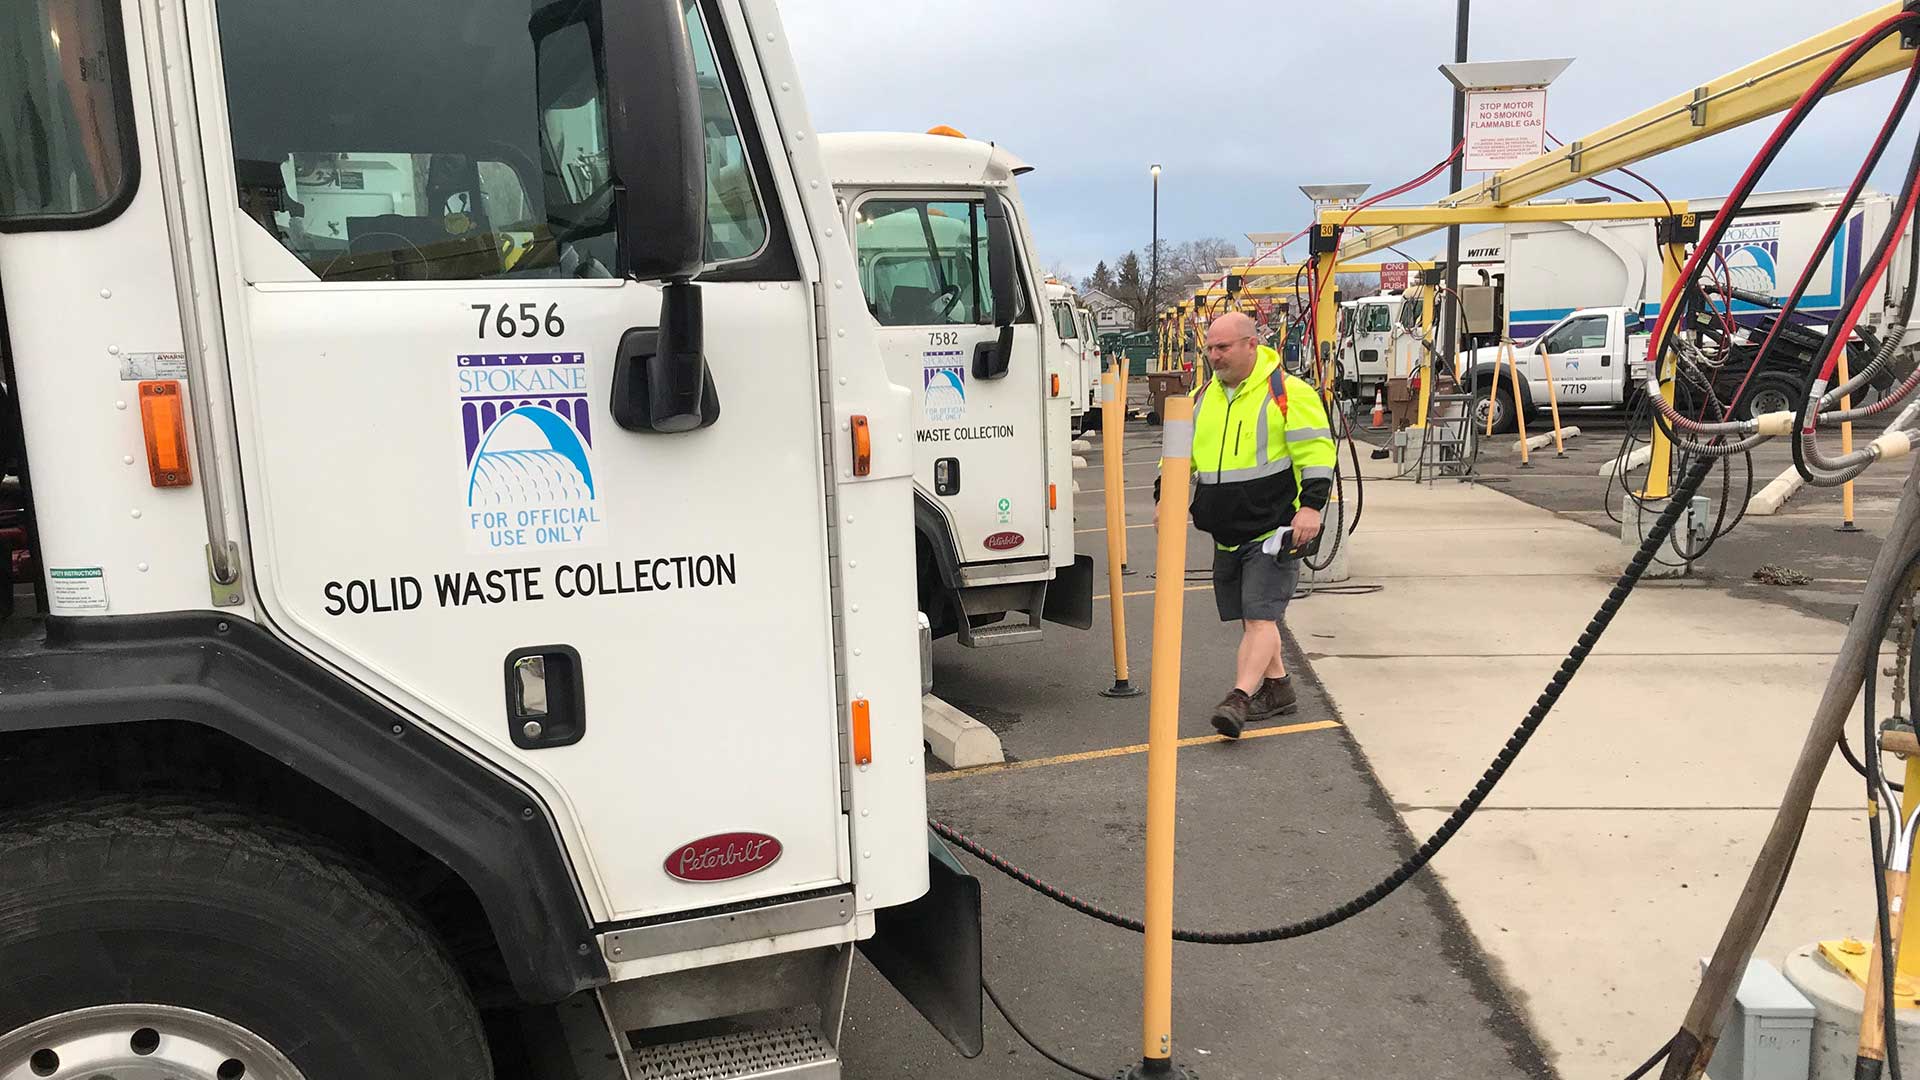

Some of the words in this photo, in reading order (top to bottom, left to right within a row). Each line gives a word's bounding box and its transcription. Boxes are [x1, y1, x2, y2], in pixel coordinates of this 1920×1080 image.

[1479, 102, 1501, 110] STOP
[1503, 101, 1534, 109] MOTOR
[1494, 110, 1533, 119] SMOKING
[1470, 120, 1521, 128] FLAMMABLE
[1682, 215, 1695, 225] 29
[1321, 225, 1333, 236] 30
[1723, 226, 1780, 241] POKANE
[1467, 247, 1501, 257] WITTKE
[471, 302, 566, 339] 7656
[928, 332, 959, 346] 7582
[459, 355, 529, 365] CITY
[551, 354, 582, 363] OF
[459, 367, 587, 393] SPOKANE
[1561, 383, 1587, 394] 7719
[916, 428, 951, 442] WASTE
[954, 425, 1014, 441] COLLECTION
[471, 512, 508, 529] FOR
[517, 507, 601, 527] OFFICIAL
[490, 529, 527, 547] USE
[536, 526, 583, 544] ONLY
[989, 535, 1021, 547] Peterbilt
[323, 576, 422, 617] SOLID
[434, 567, 543, 607] WASTE
[554, 553, 737, 599] COLLECTION
[679, 839, 771, 875] Peterbilt
